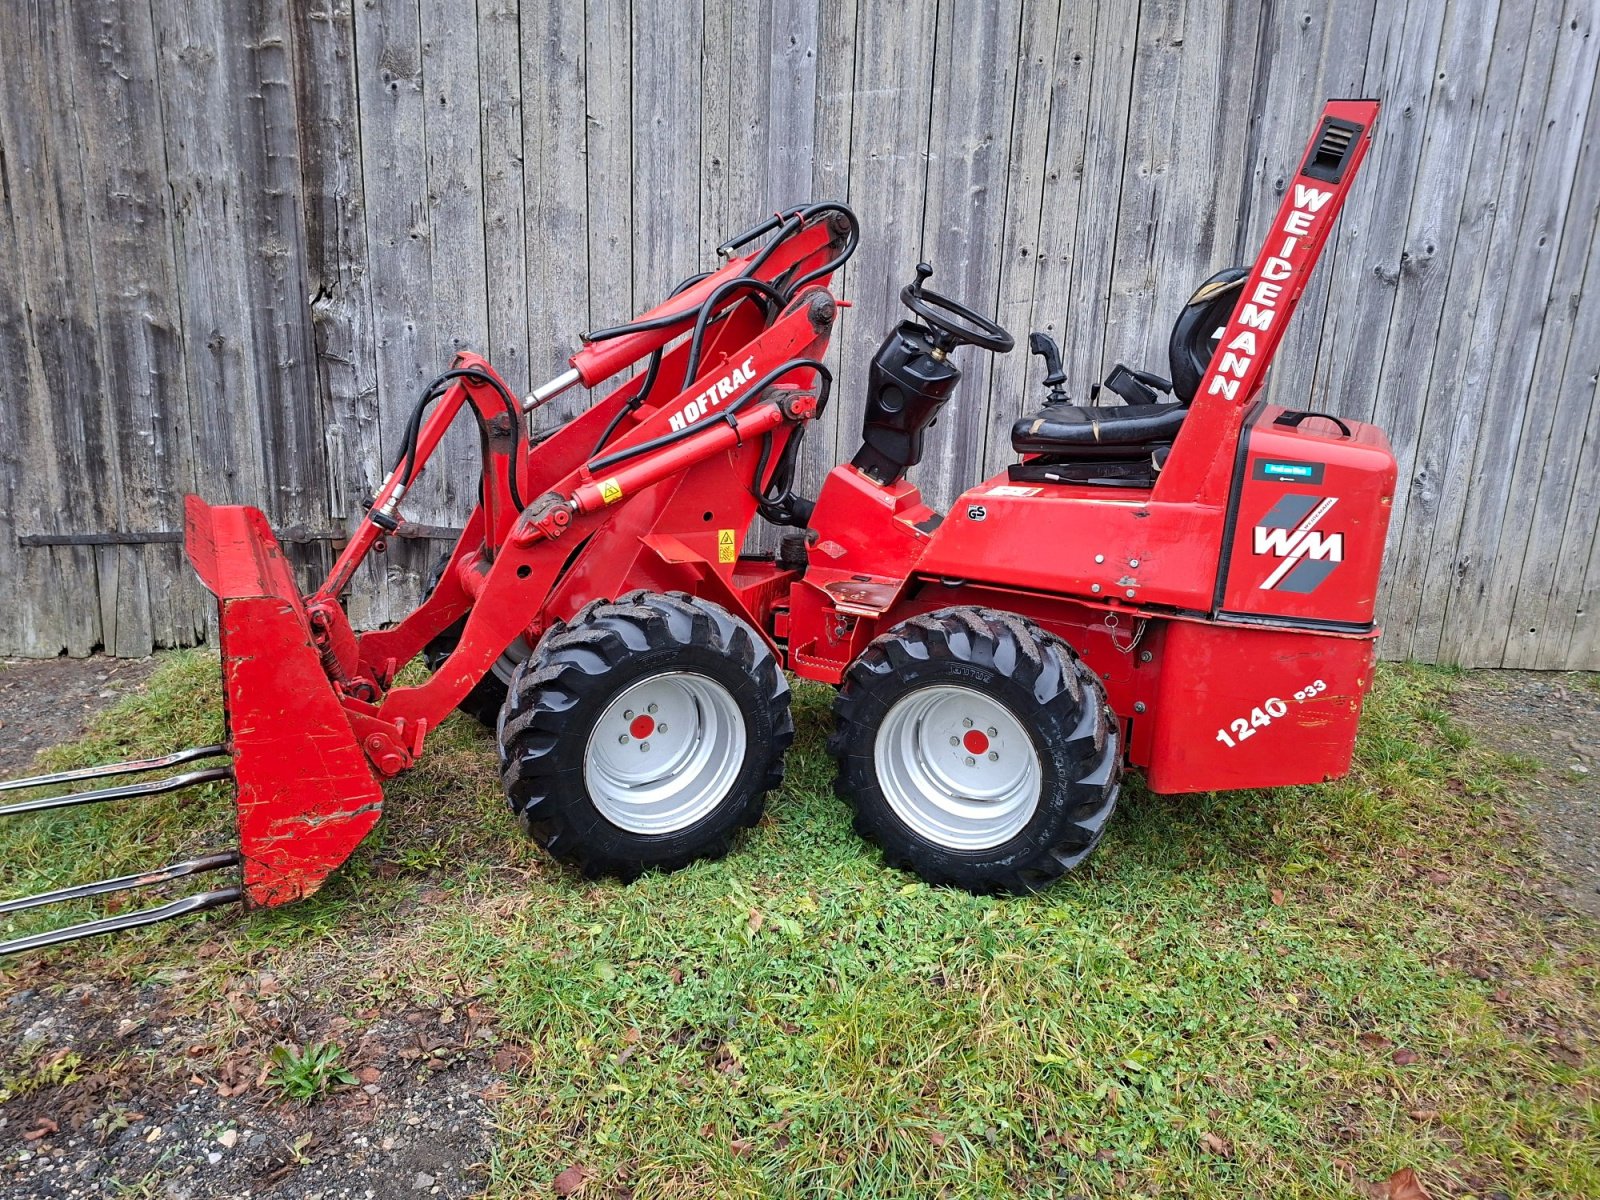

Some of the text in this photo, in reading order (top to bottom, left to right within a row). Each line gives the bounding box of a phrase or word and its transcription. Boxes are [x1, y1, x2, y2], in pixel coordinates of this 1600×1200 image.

[1208, 183, 1334, 401] WEIDEMANN
[668, 355, 757, 432] HOFTRAC
[1215, 679, 1327, 748] 1240 P33
